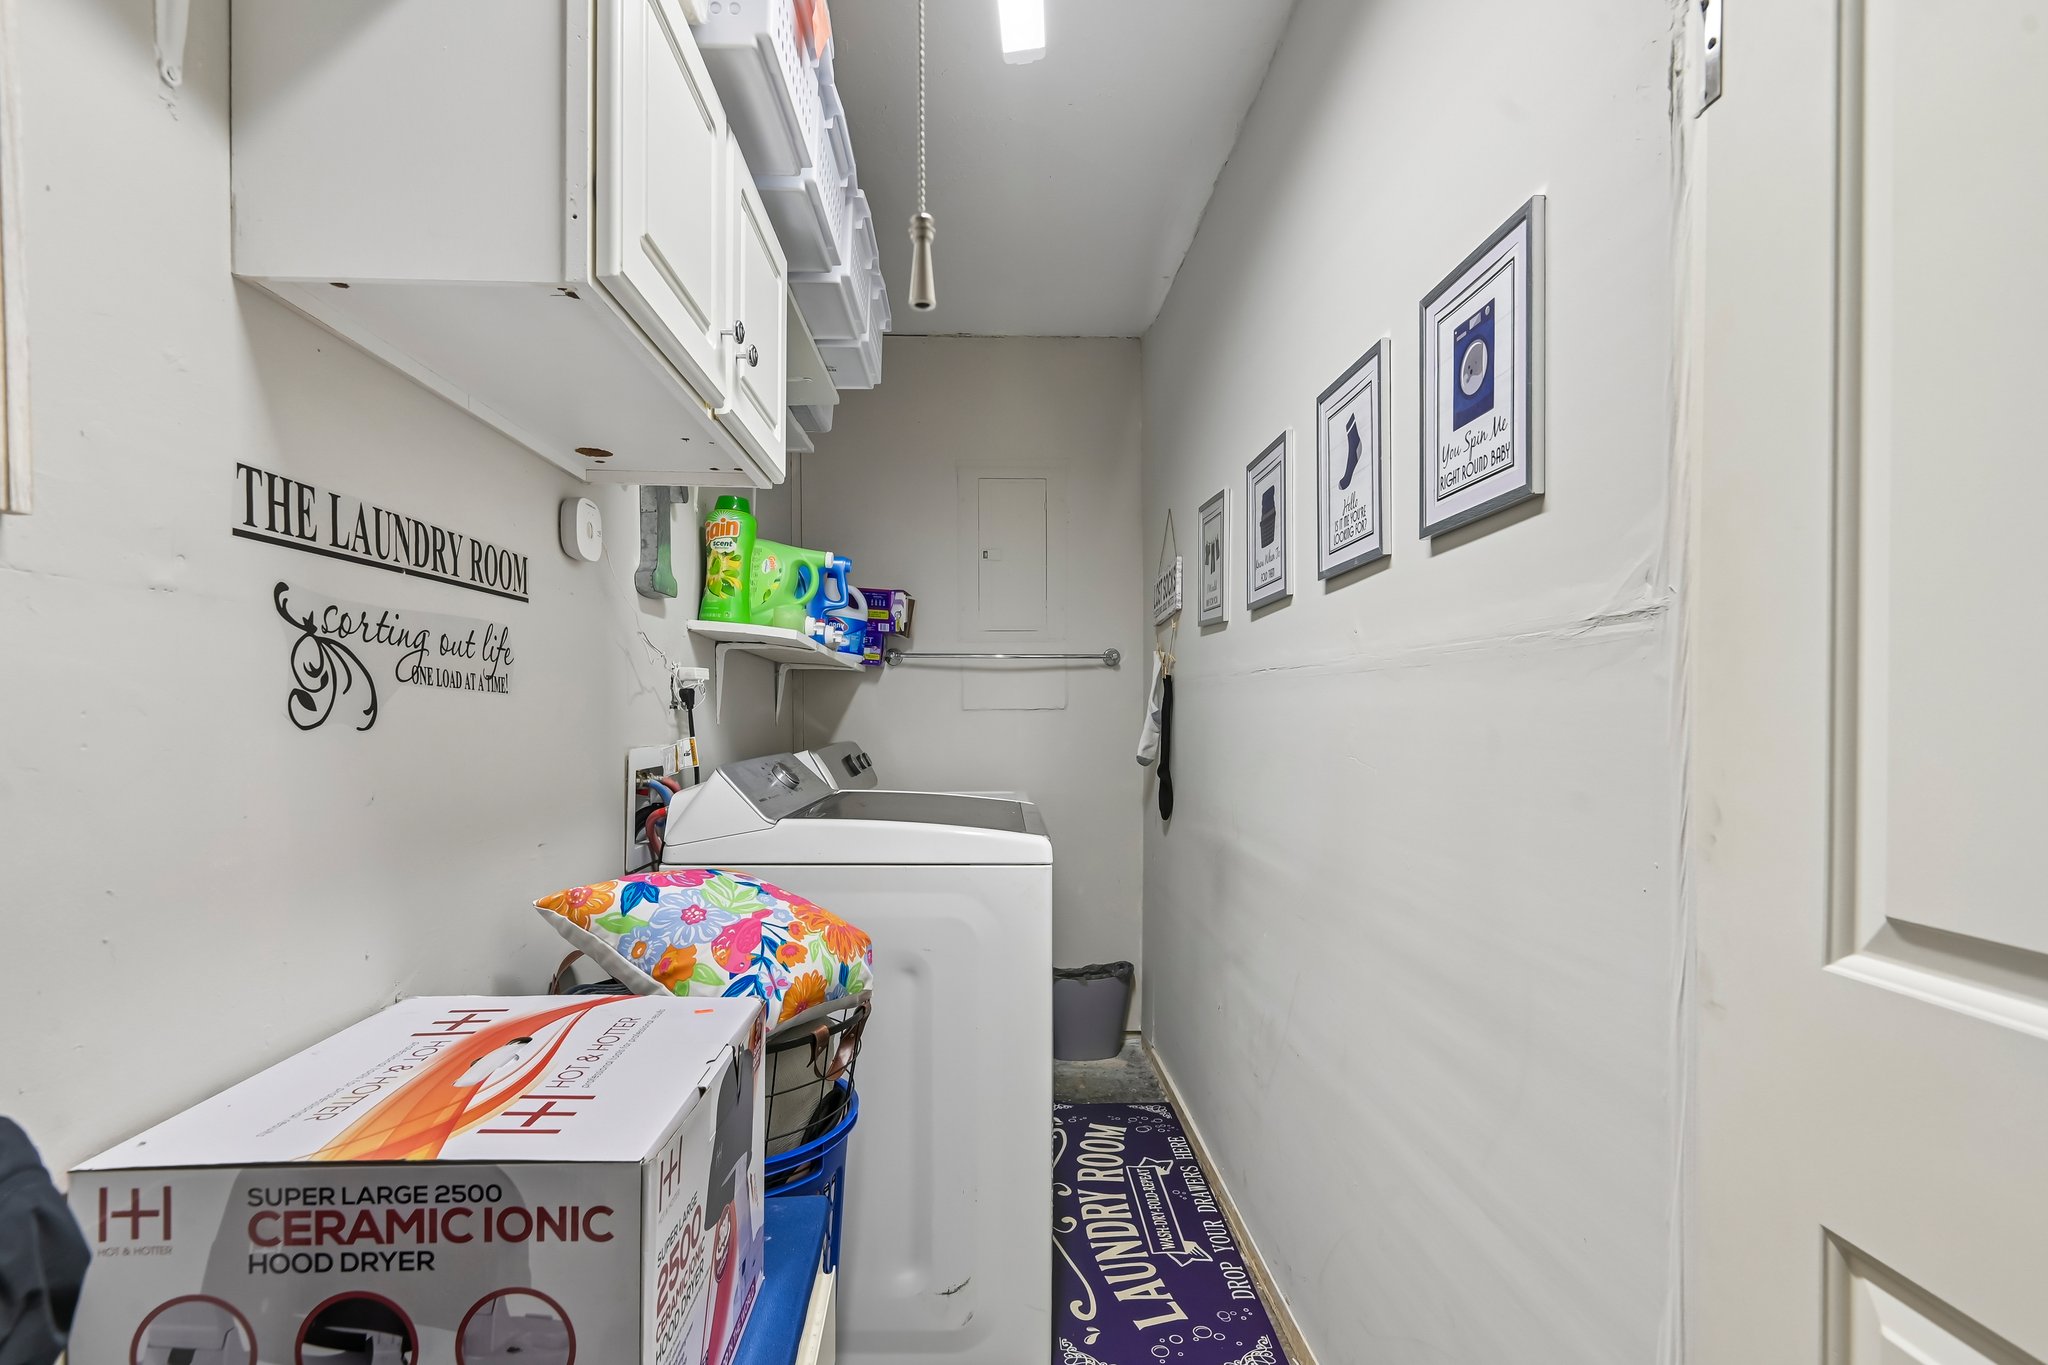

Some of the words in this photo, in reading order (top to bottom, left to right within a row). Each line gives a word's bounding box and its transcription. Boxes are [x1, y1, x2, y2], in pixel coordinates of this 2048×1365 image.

[1441, 443, 1461, 470] You
[1463, 430, 1487, 461] Spin
[1489, 415, 1508, 442] Me
[1440, 466, 1460, 491] RIGHT
[1462, 453, 1488, 480] ROUND
[1491, 441, 1510, 466] BABY
[236, 462, 317, 542] THE
[328, 492, 463, 578] LAUNDRY
[469, 538, 528, 595] ROOM
[321, 605, 430, 682] sorting
[439, 630, 475, 658] out
[482, 623, 514, 680] life
[412, 665, 433, 686] ONE
[436, 667, 462, 690] LOAD
[464, 672, 475, 691] AT
[478, 674, 486, 692] A
[486, 673, 509, 694] TIME!
[404, 1040, 452, 1061] HOT
[587, 1017, 641, 1051] HOTTER
[383, 1065, 414, 1074] &
[546, 1064, 590, 1089] HOT
[576, 1054, 604, 1062] &
[304, 1076, 398, 1121] HOTTER
[1076, 1123, 1127, 1183] ROOM
[1168, 1136, 1193, 1160] HERE
[248, 1187, 336, 1207] SUPER
[341, 1185, 428, 1206] LARGE
[434, 1183, 503, 1204] 2500
[1180, 1165, 1217, 1213] DRAWERS
[247, 1207, 473, 1248] CERAMIC
[483, 1205, 614, 1244] IONIC
[657, 1223, 678, 1268] SUPER
[679, 1190, 698, 1232] LARGE
[1203, 1219, 1234, 1253] YOUR
[97, 1247, 120, 1257] HOT
[122, 1247, 130, 1257] &
[134, 1245, 174, 1256] HOTTER
[248, 1252, 334, 1275] HOOD
[340, 1250, 435, 1274] DRYER
[656, 1204, 701, 1320] 2500
[1077, 1189, 1189, 1330] LAUNDRY
[1220, 1261, 1255, 1300] DROP
[655, 1308, 680, 1365] HOOD
[681, 1258, 704, 1318] DRYER
